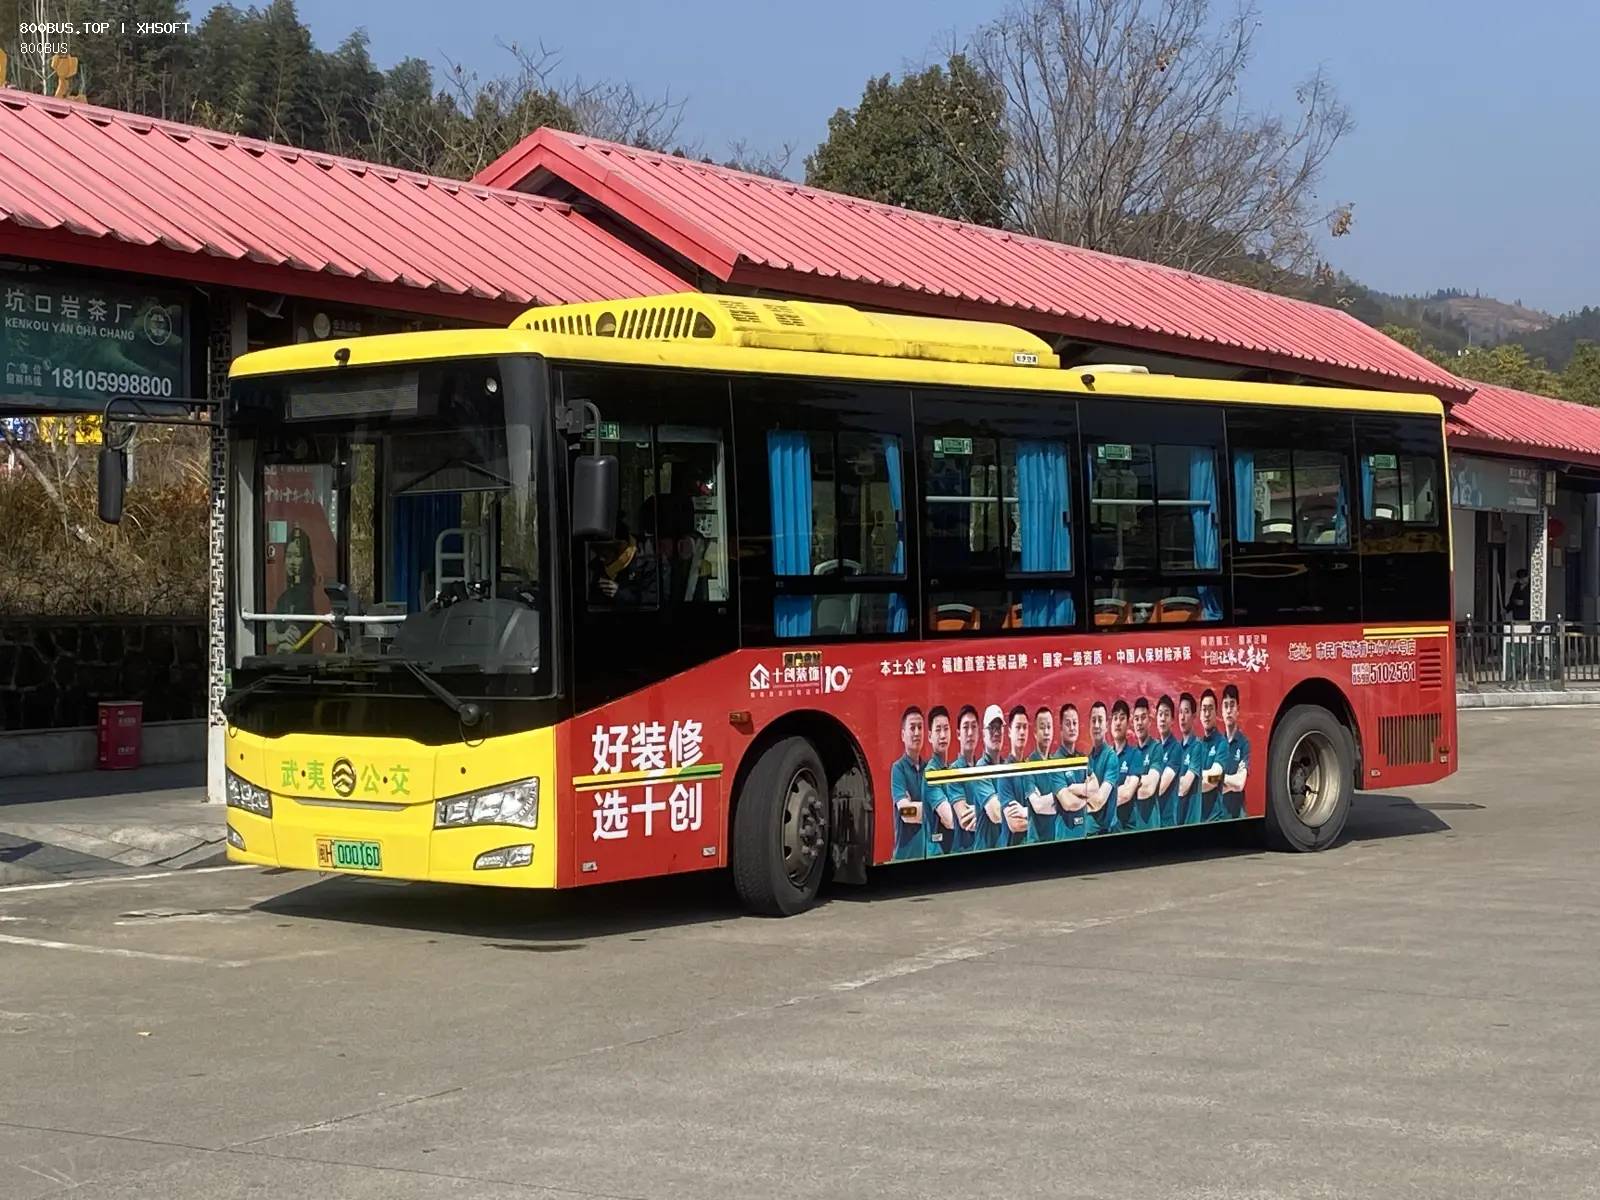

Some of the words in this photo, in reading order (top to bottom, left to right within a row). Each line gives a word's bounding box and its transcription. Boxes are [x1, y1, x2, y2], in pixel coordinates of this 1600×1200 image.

[5, 288, 133, 323] 坑口岩茶厂
[5, 317, 49, 332] KENKOU
[52, 322, 73, 334] YAN
[76, 324, 98, 337] CHA
[100, 327, 135, 341] CHANG
[51, 367, 172, 397] 18105998800
[772, 666, 820, 684] 十创装饰
[880, 658, 926, 676] 本土企业
[942, 653, 1028, 674] 福建直营连锁品牌
[1042, 649, 1103, 668] 国家一级资质
[1116, 646, 1192, 664] 中国人保财险承保
[1370, 661, 1417, 685] 5102531
[592, 719, 704, 775] 好装修
[281, 758, 326, 791] 武夷
[360, 763, 411, 796] 公交
[593, 782, 703, 842] 选十创
